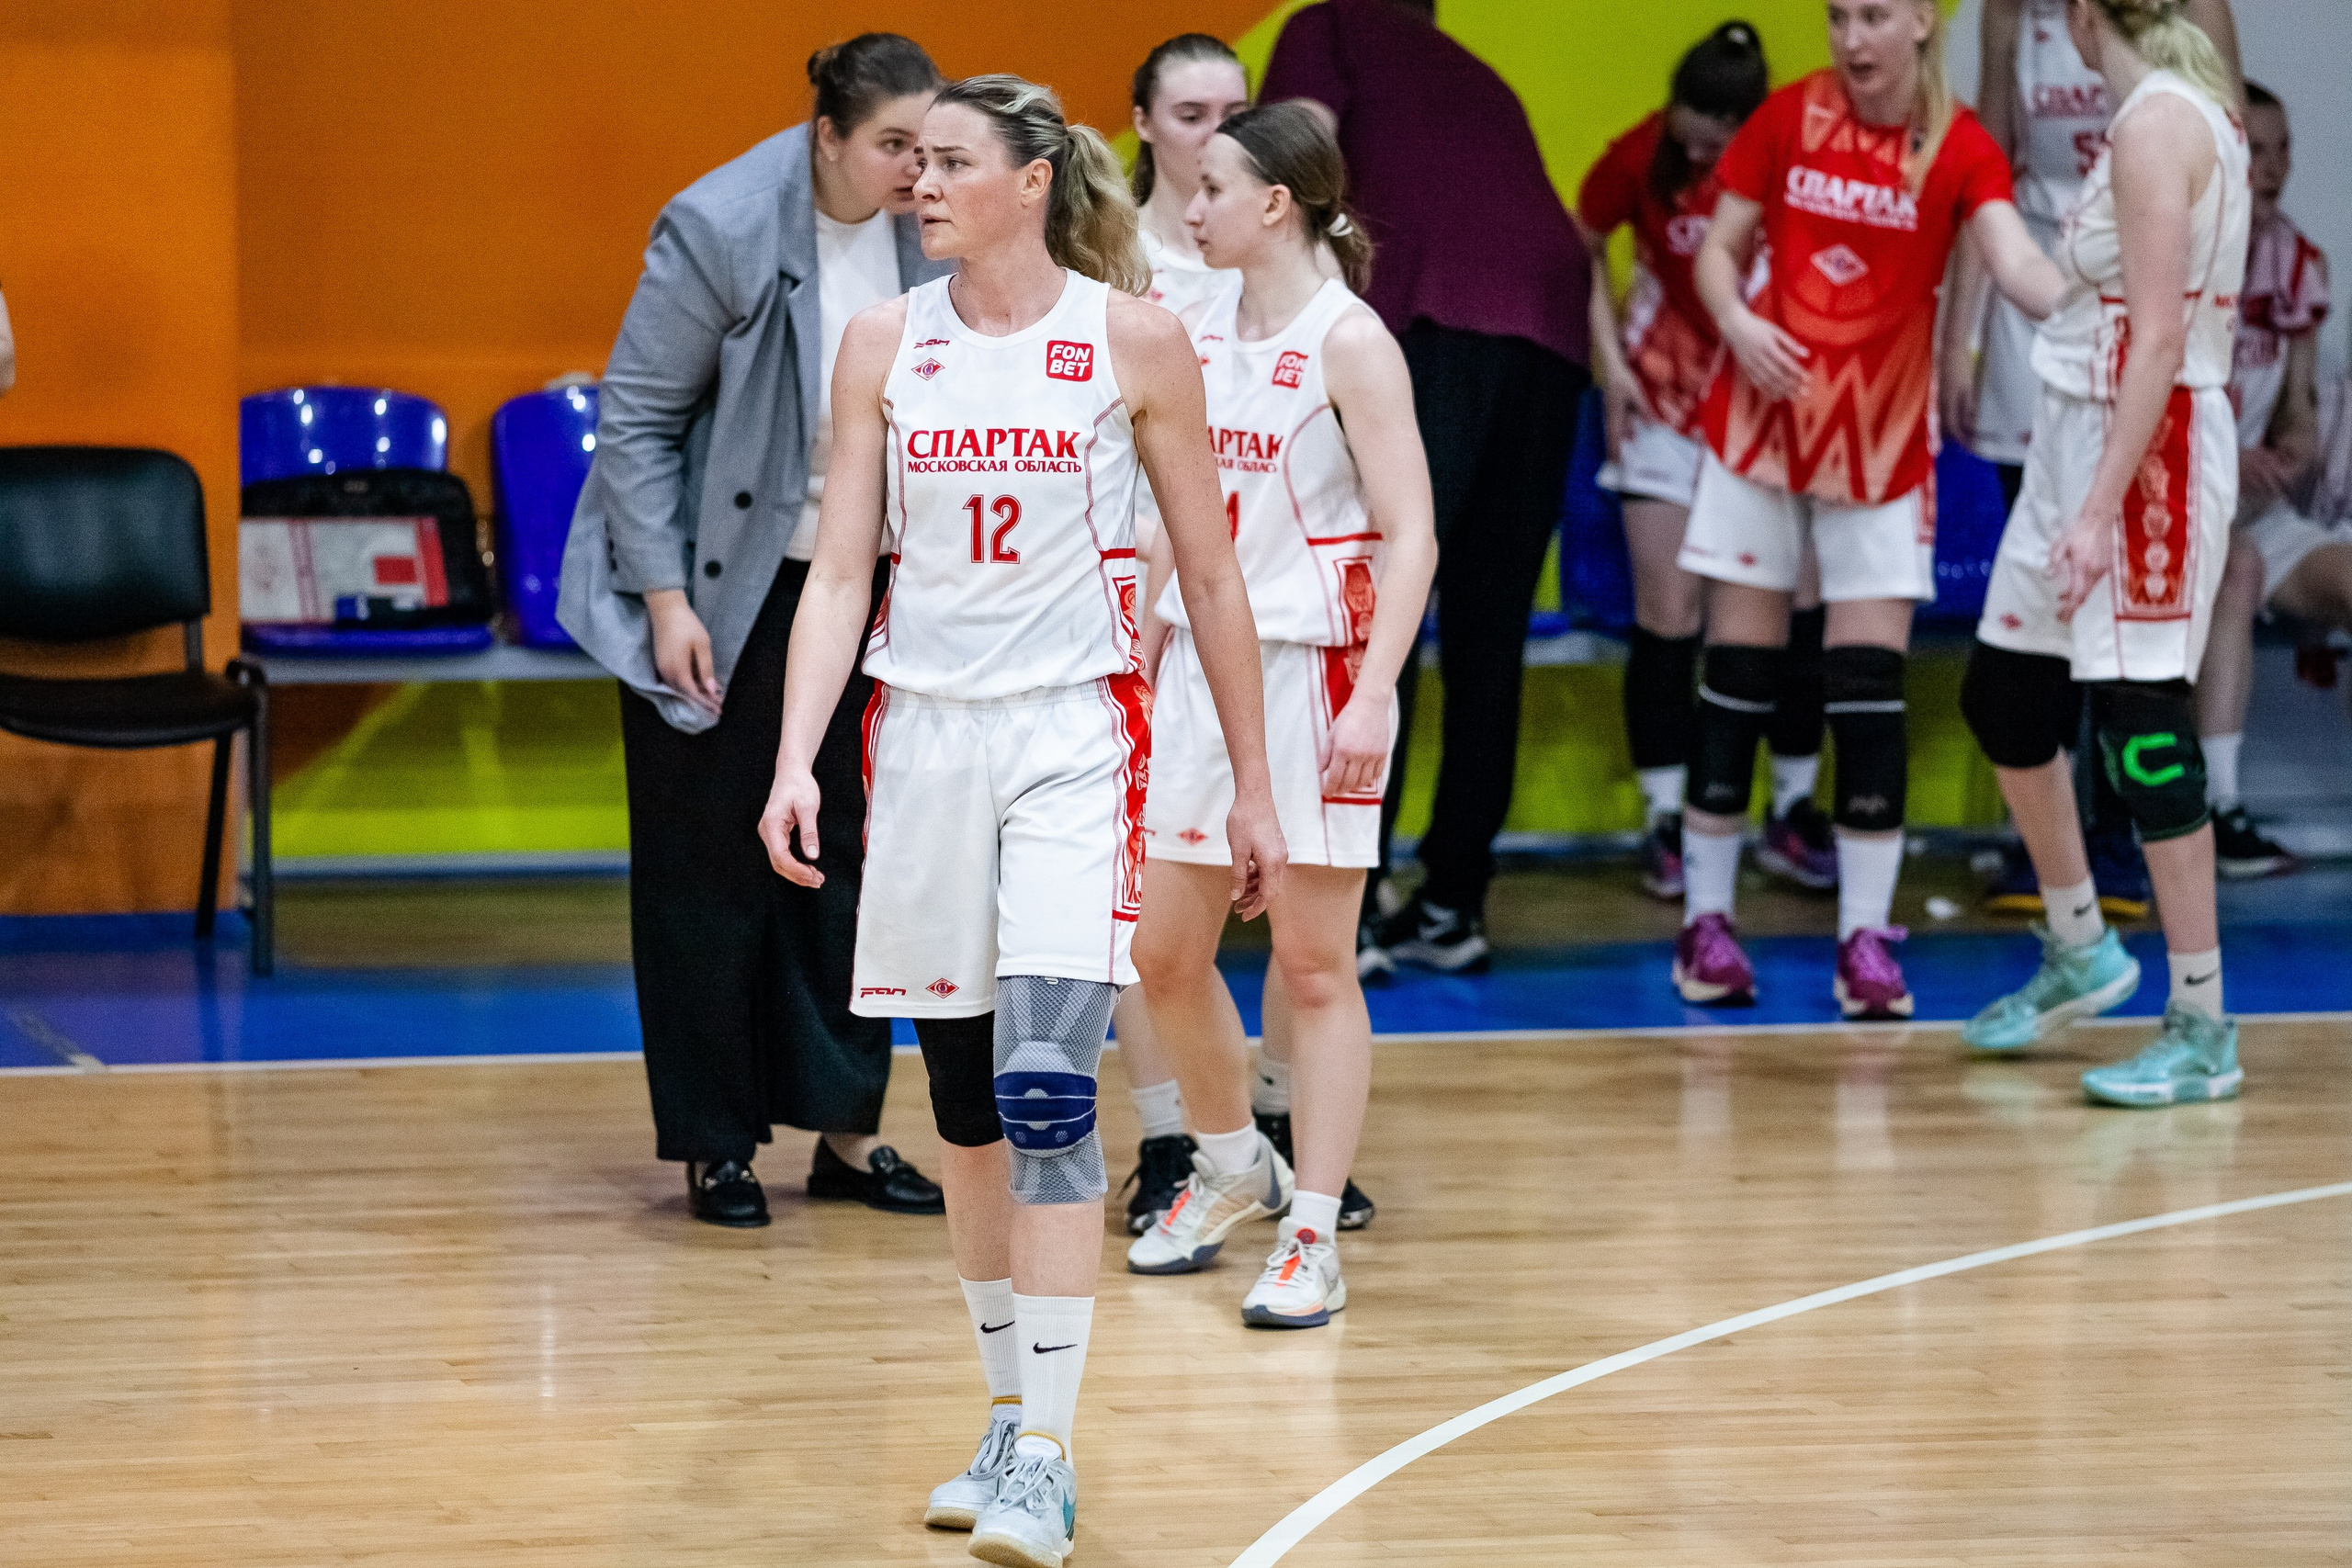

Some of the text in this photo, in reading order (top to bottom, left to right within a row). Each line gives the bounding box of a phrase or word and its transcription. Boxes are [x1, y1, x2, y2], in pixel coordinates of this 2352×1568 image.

[1050, 344, 1091, 361] FON
[1049, 359, 1090, 377] BET
[907, 428, 1081, 459] СПАРТАК
[1208, 426, 1283, 460] АРТАК
[907, 460, 1082, 473] МОСКОВСКАЯ ОБЛАСТЬ
[962, 494, 1023, 564] 12
